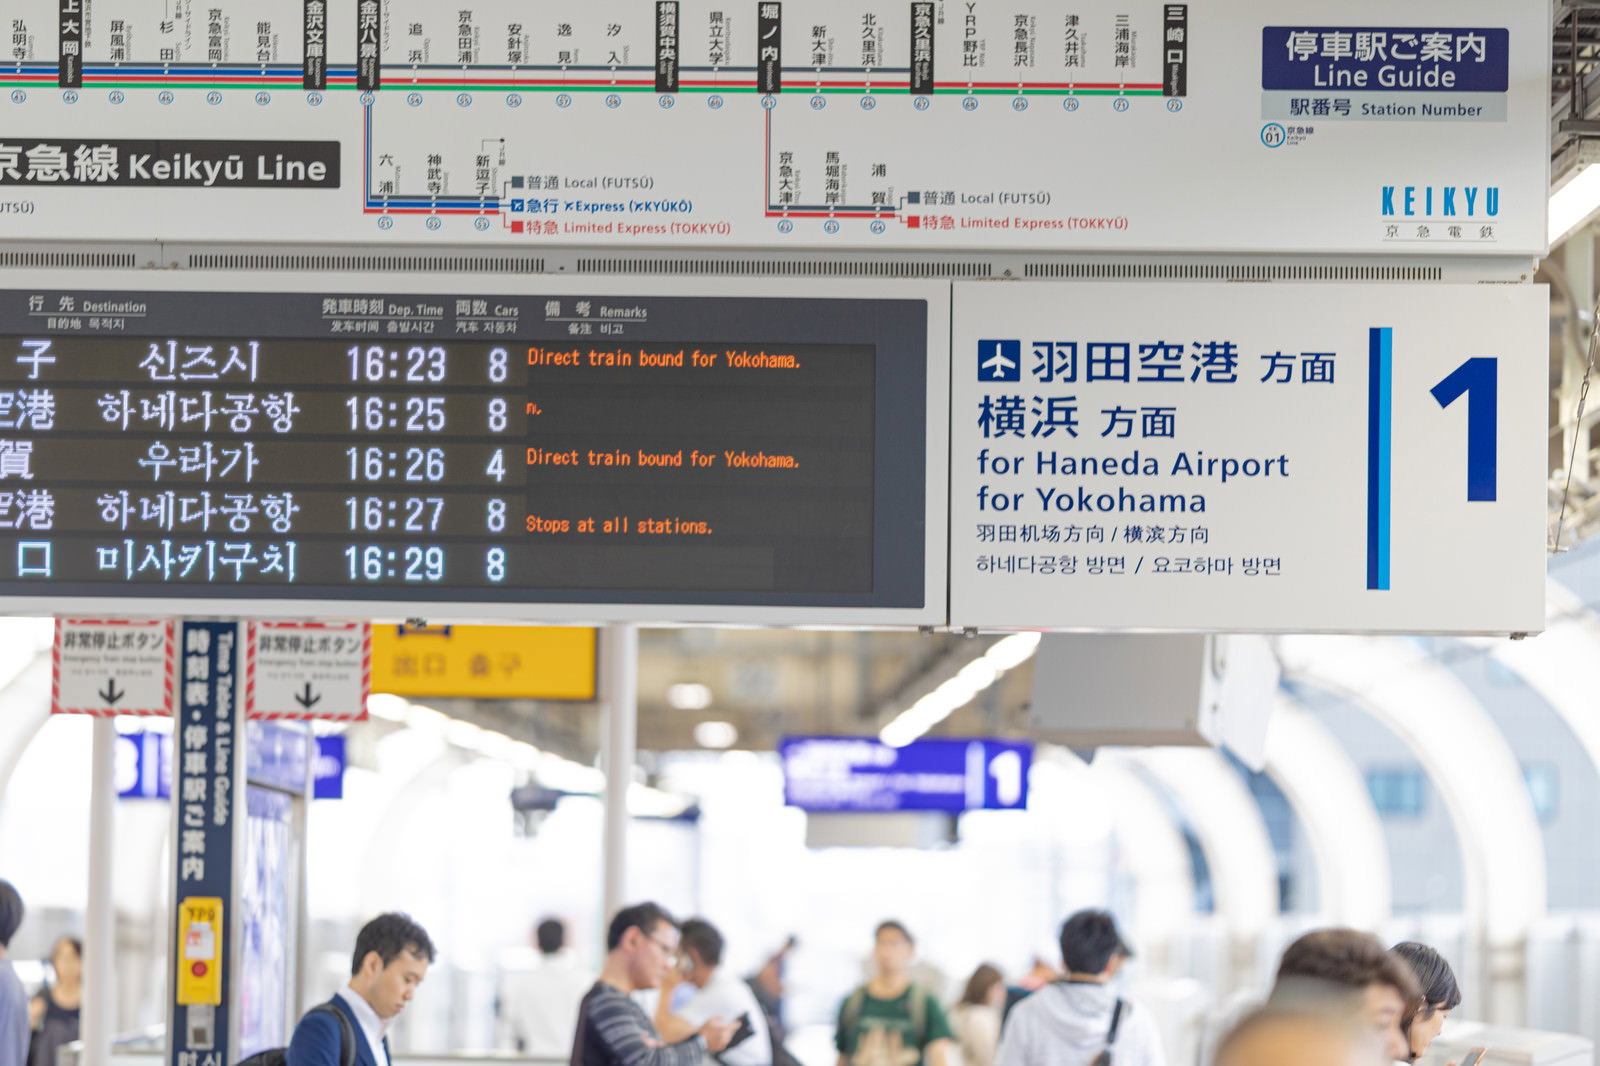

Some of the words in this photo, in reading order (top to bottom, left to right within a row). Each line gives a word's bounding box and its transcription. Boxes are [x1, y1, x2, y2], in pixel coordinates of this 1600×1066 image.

[13, 20, 26, 59] 弘明寺
[111, 21, 124, 60] 屏風浦
[160, 21, 173, 60] 杉田
[209, 9, 222, 61] 京急富岡
[257, 22, 270, 61] 能見台
[307, 0, 323, 57] 金沢文庫
[361, 0, 377, 57] 金沢八景
[409, 23, 422, 62] 追浜
[458, 10, 472, 63] 京急田浦
[508, 24, 522, 63] 安針塚
[558, 24, 571, 63] 逸見
[608, 24, 621, 64] 汐入
[660, 2, 676, 60] 横須賀中央
[710, 12, 723, 65] 県立大学
[761, 4, 778, 61] 堀ノ内
[812, 26, 826, 65] 新大津
[862, 13, 876, 65] 北久里浜
[915, 4, 931, 63] 京急久里浜
[1014, 14, 1028, 66] 京急長沢
[1065, 15, 1079, 67] 津久井浜
[1115, 15, 1129, 67] 三浦海岸
[1167, 7, 1184, 65] 三崎口
[1286, 31, 1485, 62] 停車駅ご案内
[1315, 64, 1367, 86] Line
[1378, 64, 1455, 87] Guide
[1291, 98, 1351, 116] 駅番号
[1362, 103, 1415, 115] Station
[1422, 104, 1482, 116] Number
[129, 153, 244, 186] Keikyū
[258, 155, 326, 181] Line
[379, 154, 393, 194] 六浦
[428, 154, 441, 194] 神武寺
[476, 155, 489, 195] 新逗子
[528, 176, 558, 189] 普通
[565, 177, 597, 188] Local
[780, 152, 792, 203] 京急大津
[826, 152, 839, 204] 馬堀海岸
[872, 164, 886, 204] 浦賀
[527, 199, 558, 213] 急行
[576, 201, 624, 214] Express
[924, 191, 955, 205] 普通
[962, 192, 993, 203] Local
[1382, 186, 1498, 216] KEIKYU
[527, 220, 558, 234] 特急
[565, 222, 612, 233] Limited
[618, 223, 666, 235] Express
[923, 216, 955, 229] 特急
[961, 217, 1009, 228] Limited
[1015, 218, 1063, 230] Express
[1386, 225, 1492, 238] 京急電鉄
[29, 296, 74, 311] 行先
[84, 301, 146, 312] Destination
[48, 318, 81, 329] 目的地
[323, 299, 384, 314] 発車時刻
[387, 304, 414, 318] Dep.
[417, 304, 443, 315] Time
[456, 300, 487, 315] 両数
[495, 305, 518, 316] Cars
[545, 301, 591, 317] 備考
[601, 306, 647, 317] Remarks
[600, 324, 623, 335] 비고
[139, 340, 259, 382] 신즈시
[347, 346, 446, 382] 16:23
[489, 348, 507, 382] 8
[528, 348, 580, 365] Direct
[588, 349, 631, 366] train
[639, 350, 683, 367] bound
[692, 350, 717, 367] for
[726, 351, 800, 368] Yokohama.
[1032, 341, 1238, 383] 羽田空港
[1261, 352, 1336, 383] 方面
[97, 390, 300, 432] 하네다공항
[346, 396, 445, 431] 16:25
[489, 398, 506, 432] 8
[978, 395, 1078, 438] 横浜
[1101, 406, 1176, 438] 方面
[1430, 357, 1497, 502] 1
[138, 441, 259, 482] 우라가
[347, 447, 444, 481] 16:26
[486, 449, 506, 482] 4
[527, 448, 578, 465] Direct
[588, 450, 630, 466] train
[638, 450, 682, 466] bound
[690, 450, 716, 467] for
[725, 451, 799, 468] Yokohama.
[977, 449, 1024, 474] for
[1038, 451, 1158, 475] Haneda
[1171, 451, 1288, 482] Airport
[96, 490, 300, 533] 하네다공항
[346, 497, 444, 531] 16:27
[488, 499, 506, 532] 8
[526, 515, 569, 534] Stops
[577, 518, 594, 533] at
[603, 517, 627, 533] all
[638, 517, 712, 534] stations.
[977, 486, 1024, 511] for
[1036, 487, 1205, 512] Yokohama
[977, 524, 1103, 543] 羽田机场方向
[1124, 525, 1208, 543] 横滨方向
[96, 539, 296, 582] 미사키구치
[345, 545, 444, 581] 16:29
[487, 547, 504, 581] 8
[977, 555, 1077, 574] 하네다공항
[1087, 556, 1124, 574] 방면
[1153, 557, 1233, 575] 요코하마
[1243, 558, 1280, 575] 방면
[64, 632, 163, 650] 非常停止ボタン
[987, 750, 1022, 806] 1
